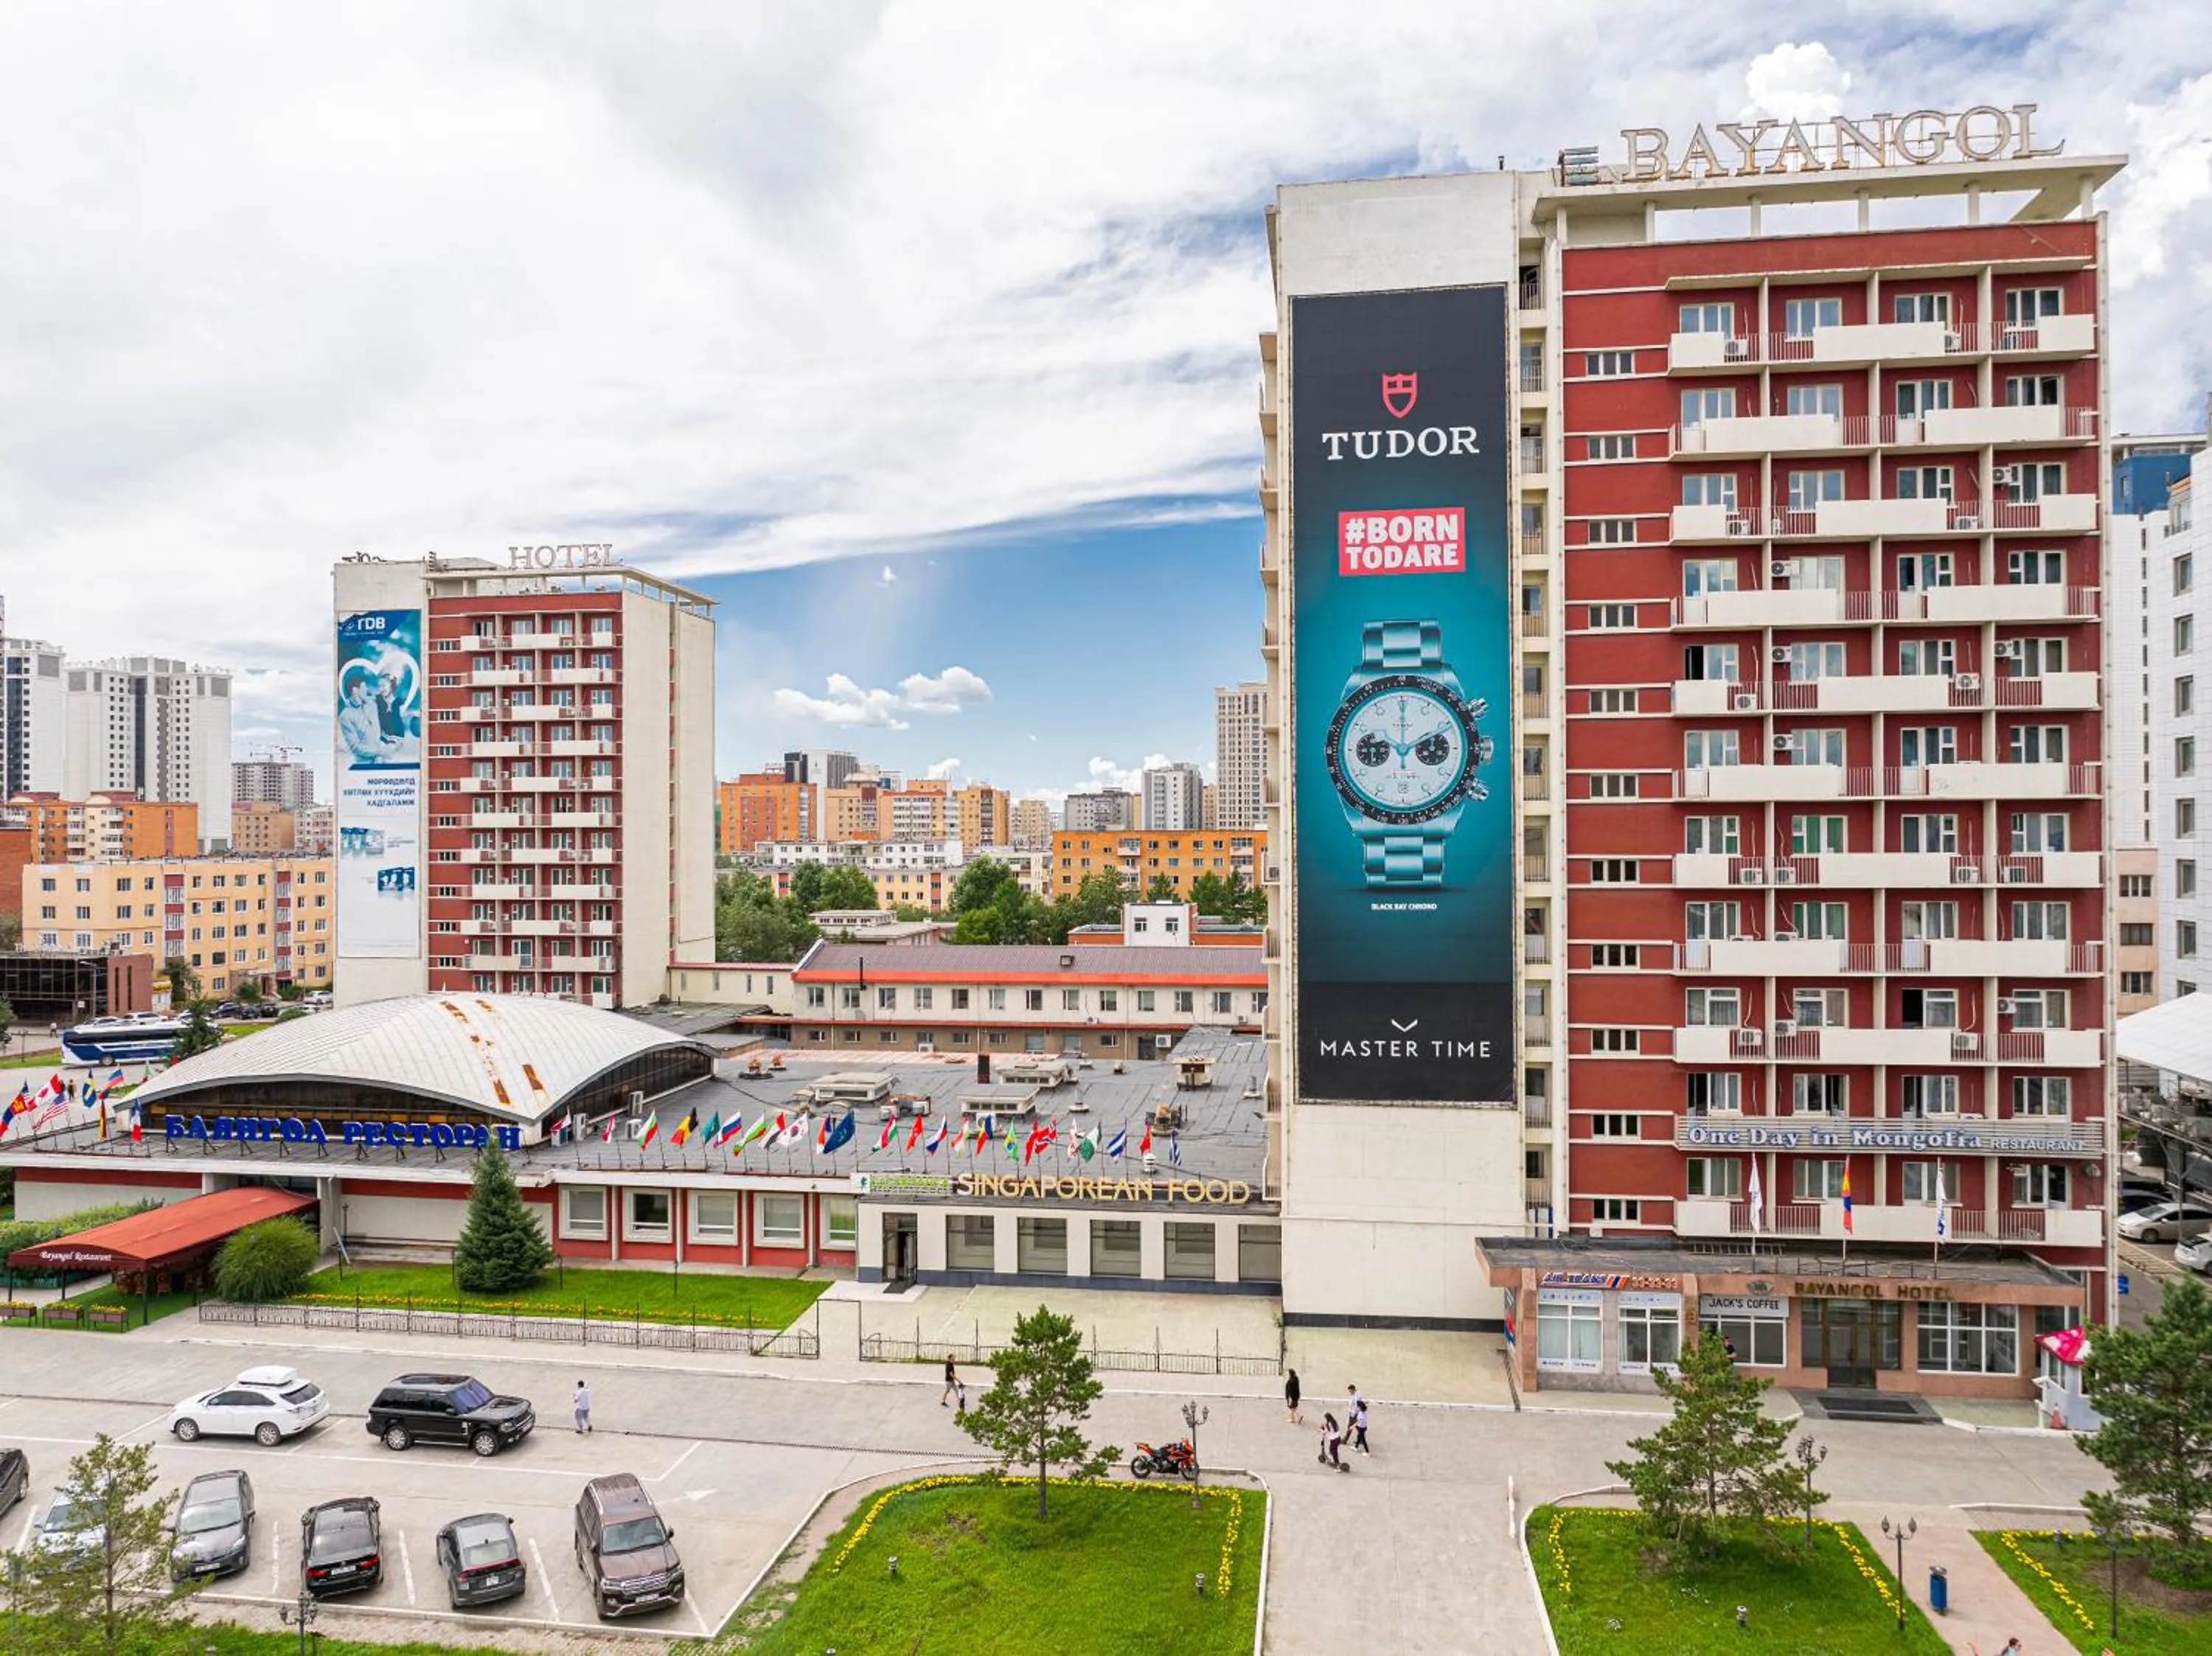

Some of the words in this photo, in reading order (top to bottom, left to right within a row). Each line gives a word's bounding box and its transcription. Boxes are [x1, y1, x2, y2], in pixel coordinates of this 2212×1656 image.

[1621, 103, 2066, 182] BAYANGOL
[1322, 425, 1480, 461] TUDOR
[1345, 514, 1458, 544] #BORN
[508, 543, 624, 569] HOTEL
[1346, 543, 1458, 570] TODARE
[1321, 1040, 1419, 1057] MASTER
[1432, 1040, 1491, 1058] TIME
[164, 1114, 329, 1145] БАЯНГОЛ
[343, 1121, 521, 1151] РЕСТОРАН
[1688, 1124, 1740, 1144] One
[1747, 1126, 1801, 1149] Day
[1809, 1126, 1839, 1145] in
[1850, 1128, 1983, 1150] Mongolia
[1991, 1138, 2086, 1152] RESTAURANT
[956, 1172, 1154, 1201] SINGAPOREAN
[1167, 1178, 1251, 1204] FOOD
[1708, 1298, 1743, 1308] JACK'S
[1747, 1298, 1779, 1309] COFFEE
[1794, 1281, 1884, 1298] BAYANGOL
[1896, 1285, 1955, 1300] HOTEL
